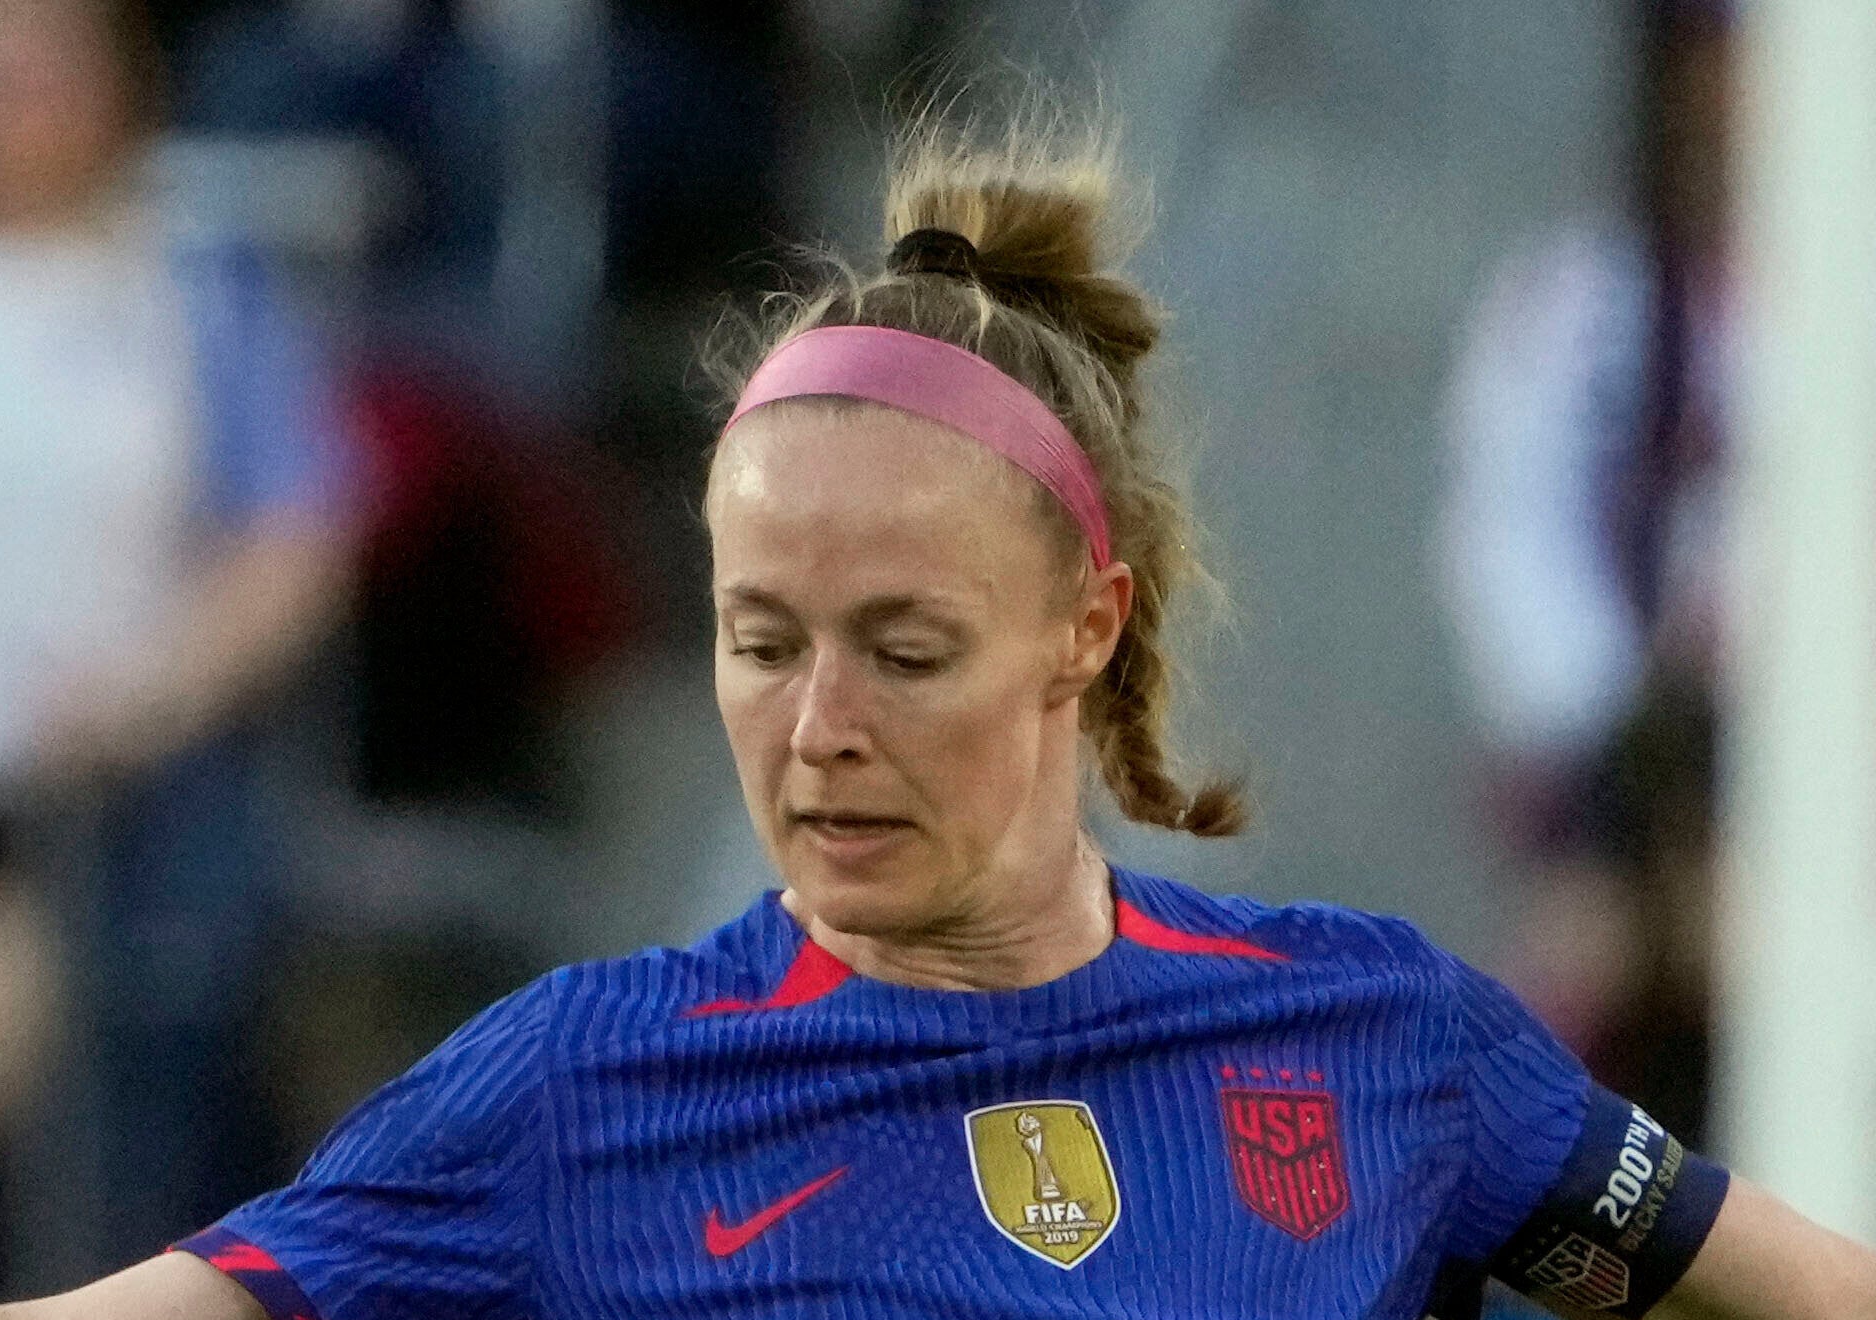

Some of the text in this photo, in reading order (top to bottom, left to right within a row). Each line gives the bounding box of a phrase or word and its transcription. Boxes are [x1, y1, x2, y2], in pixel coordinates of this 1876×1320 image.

[1232, 1098, 1326, 1158] USA
[1024, 1202, 1087, 1224] FIFA
[1044, 1230, 1080, 1244] 2019
